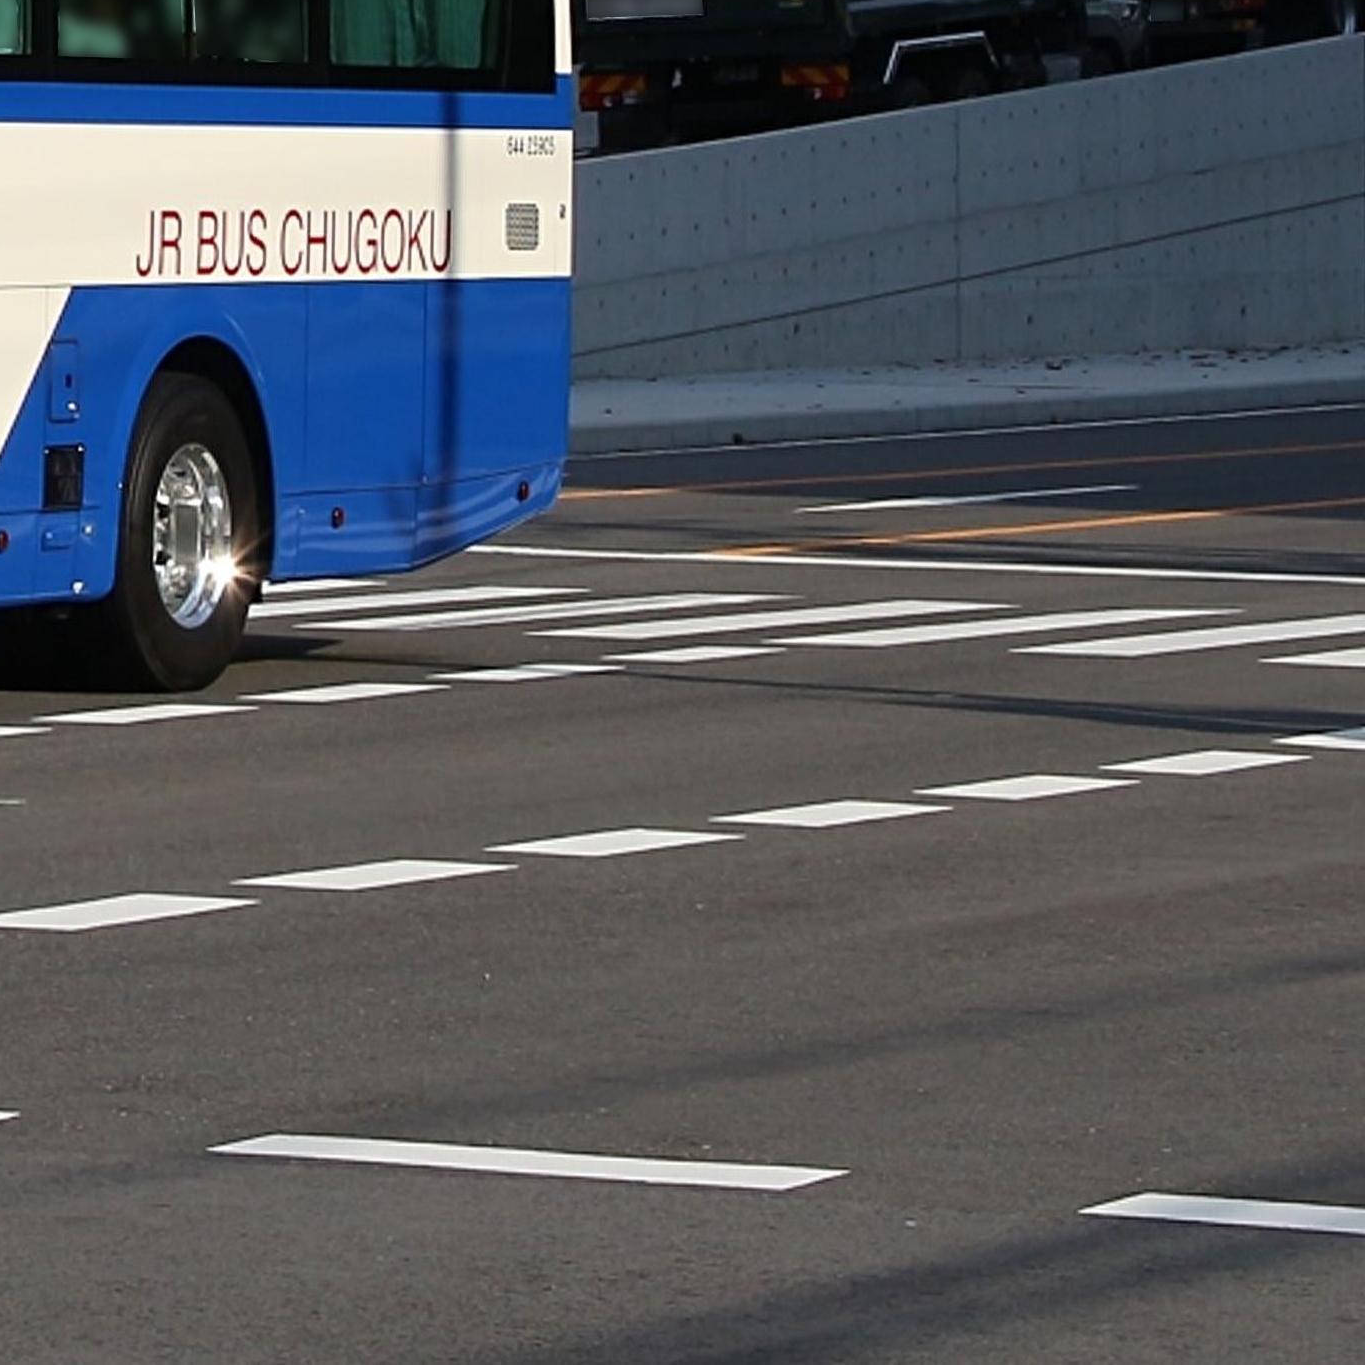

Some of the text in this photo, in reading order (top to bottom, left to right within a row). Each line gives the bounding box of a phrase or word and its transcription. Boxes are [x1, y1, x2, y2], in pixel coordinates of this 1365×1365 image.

[136, 207, 453, 277] JR BUS CHUGOKU
